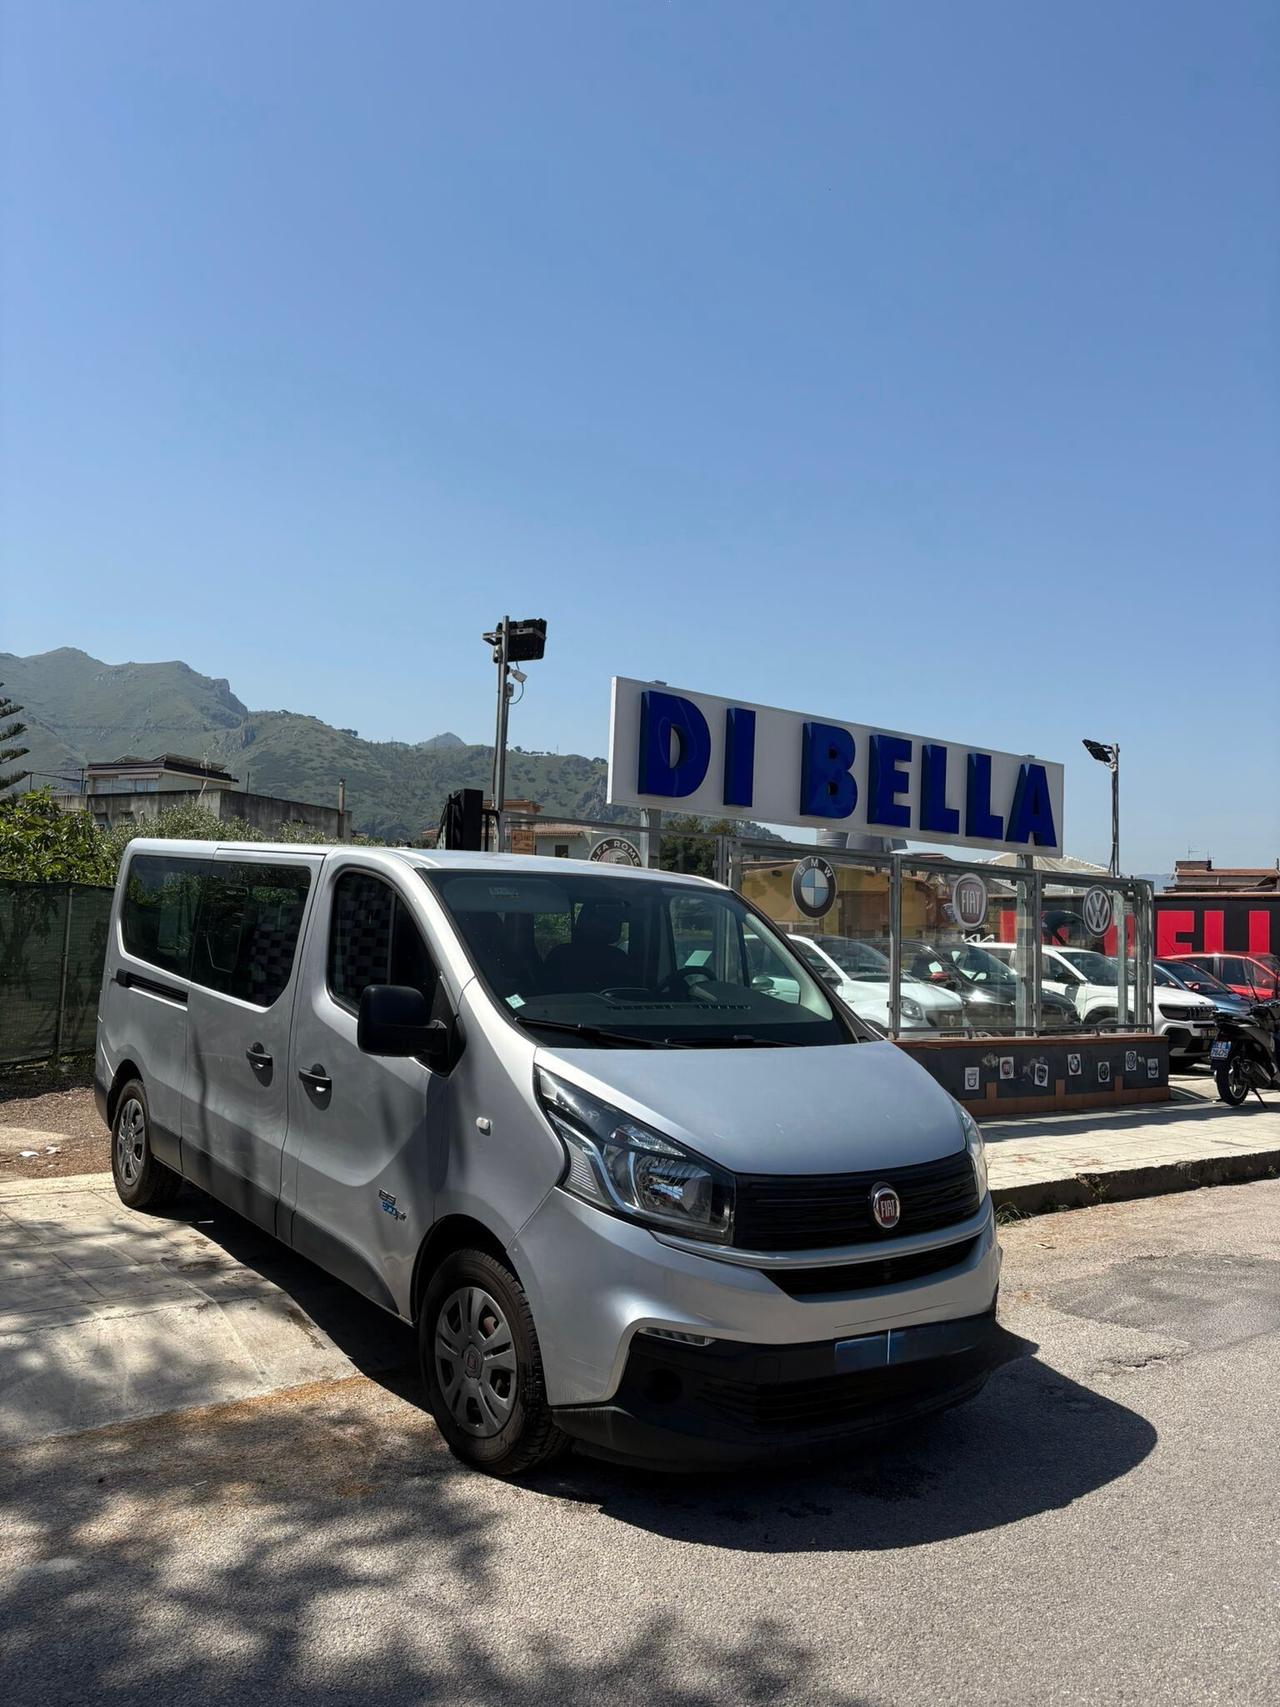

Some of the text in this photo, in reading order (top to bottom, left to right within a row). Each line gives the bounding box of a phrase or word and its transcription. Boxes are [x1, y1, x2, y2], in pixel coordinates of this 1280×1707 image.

[638, 690, 1057, 847] DI BELLA
[613, 840, 640, 866] ROME
[797, 858, 833, 878] BMW
[961, 889, 981, 914] FIAT
[880, 1199, 896, 1217] FIAT
